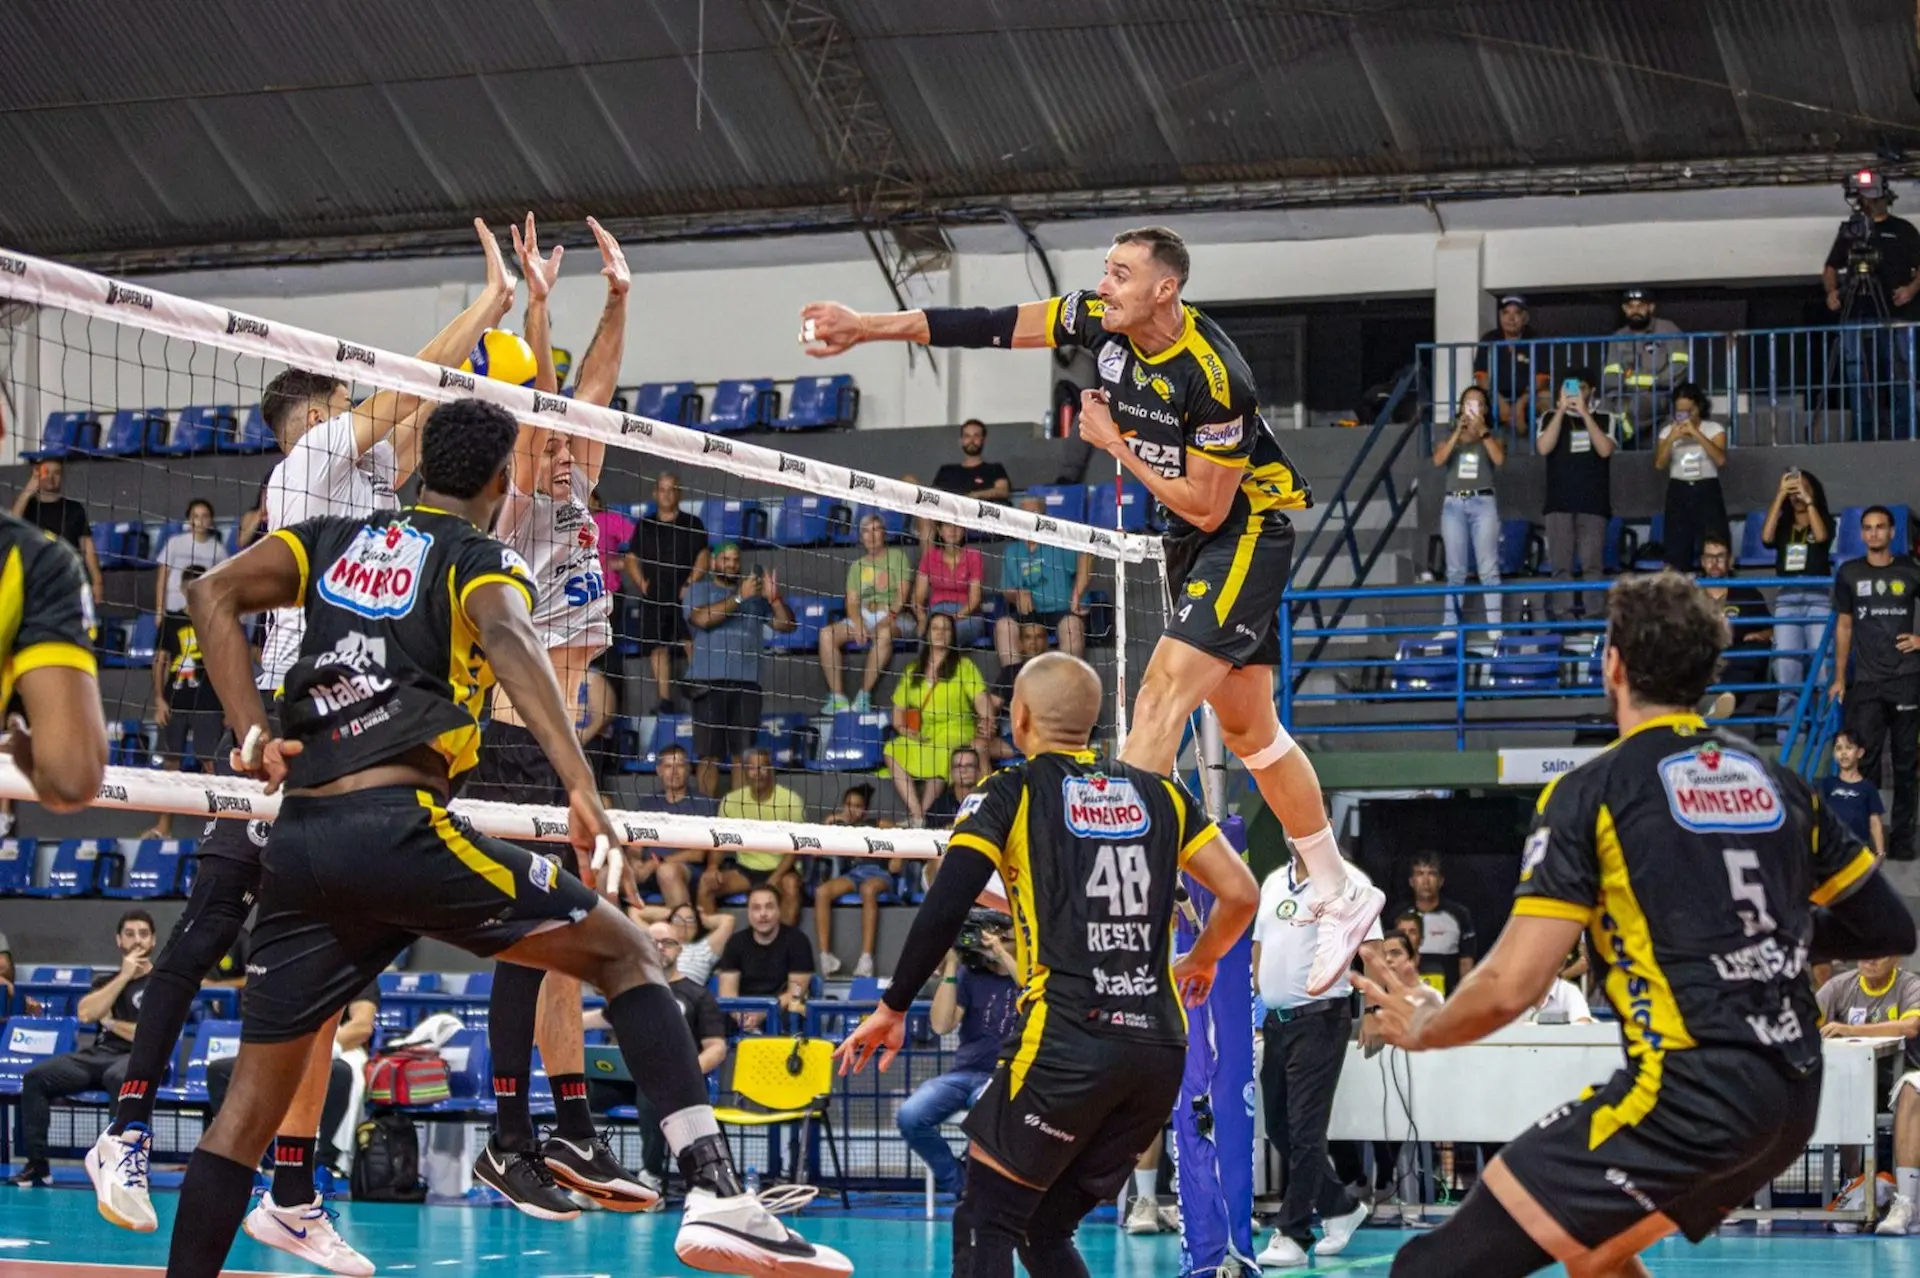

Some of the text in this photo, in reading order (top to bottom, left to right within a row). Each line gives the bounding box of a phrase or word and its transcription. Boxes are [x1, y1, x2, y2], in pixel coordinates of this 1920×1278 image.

[116, 287, 153, 311] SUPERLIGA
[235, 317, 269, 339] SUPERLIGA
[345, 345, 376, 368] SUPERLIGA
[447, 371, 475, 393] SUPERLIGA
[540, 397, 567, 416] SUPERLIGA
[1118, 401, 1148, 418] praia
[628, 418, 653, 436] SUPERLIGA
[711, 438, 733, 455] SUPERLIGA
[1542, 758, 1576, 773] SAÍDA
[95, 785, 128, 803] UPERLIGA
[1677, 787, 1773, 814] MINEIRO
[217, 795, 252, 813] SUPERLIGA
[1071, 803, 1143, 825] MNEIRO
[633, 826, 659, 842] SUPERLIGA
[718, 830, 743, 846] SUPERLIGA
[1085, 845, 1151, 916] 48
[1722, 848, 1777, 937] 5
